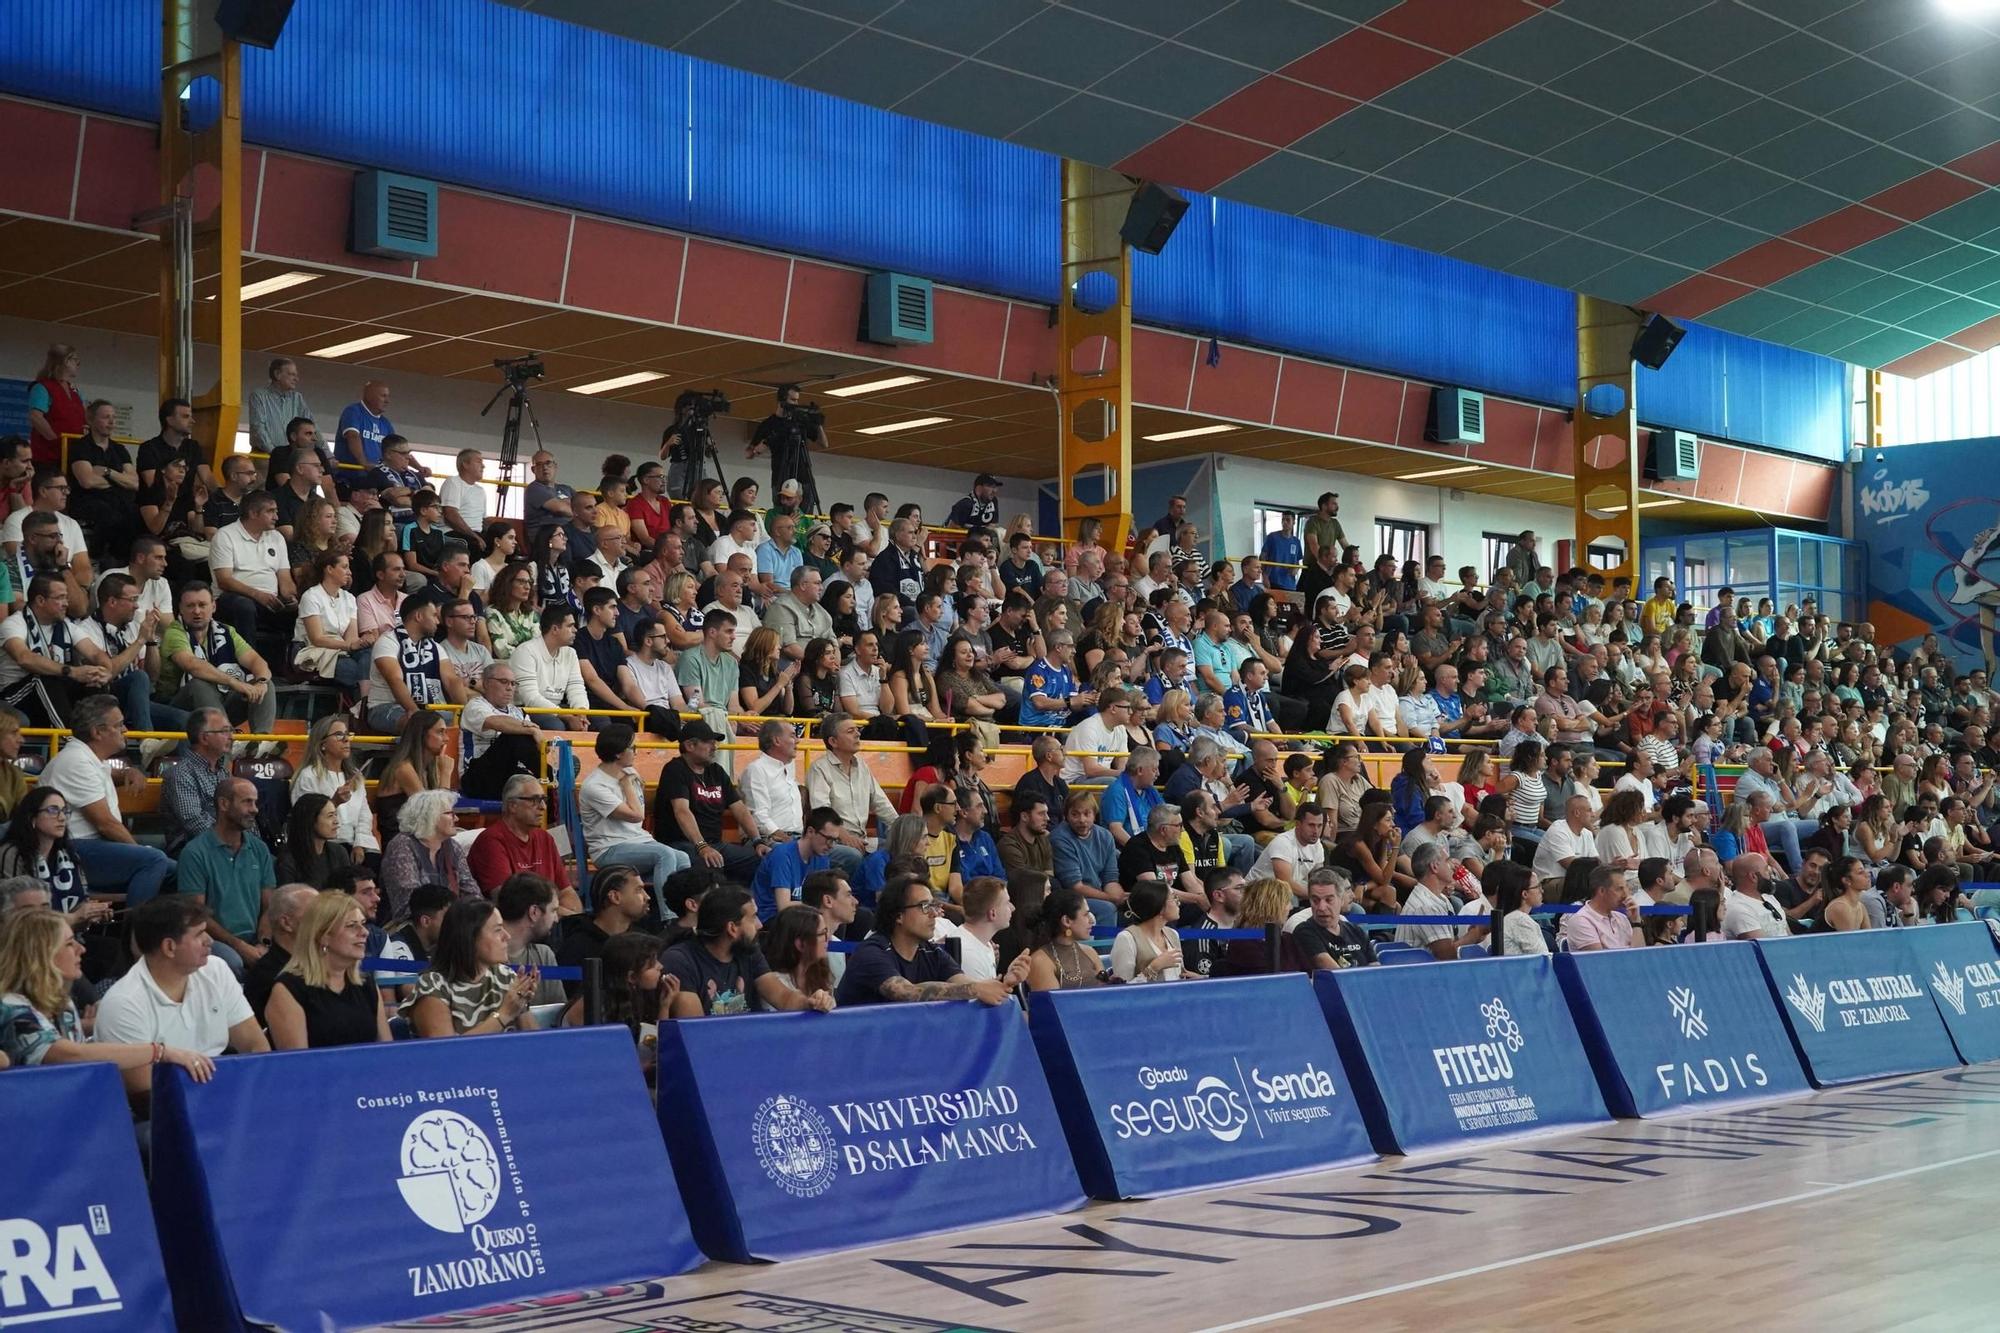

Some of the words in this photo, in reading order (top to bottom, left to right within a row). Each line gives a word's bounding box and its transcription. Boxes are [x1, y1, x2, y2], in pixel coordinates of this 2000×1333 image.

[1829, 979, 1871, 1005] CAJA
[1866, 974, 1923, 1001] RURAL
[1840, 1009, 1860, 1027] DE
[1860, 1004, 1911, 1025] ZAMORA
[1432, 1041, 1514, 1087] FITECU
[1656, 1053, 1768, 1099] FADIS
[357, 1093, 413, 1109] Consejo
[417, 1085, 487, 1104] Regulador
[1252, 1062, 1336, 1104] Senda
[1448, 1090, 1467, 1106] FERIA
[1264, 1106, 1291, 1124] Vivir
[487, 1088, 523, 1195] Denominación
[519, 1199, 530, 1218] de
[526, 1223, 547, 1275] Origen
[408, 1249, 534, 1298] ZAMORANO
